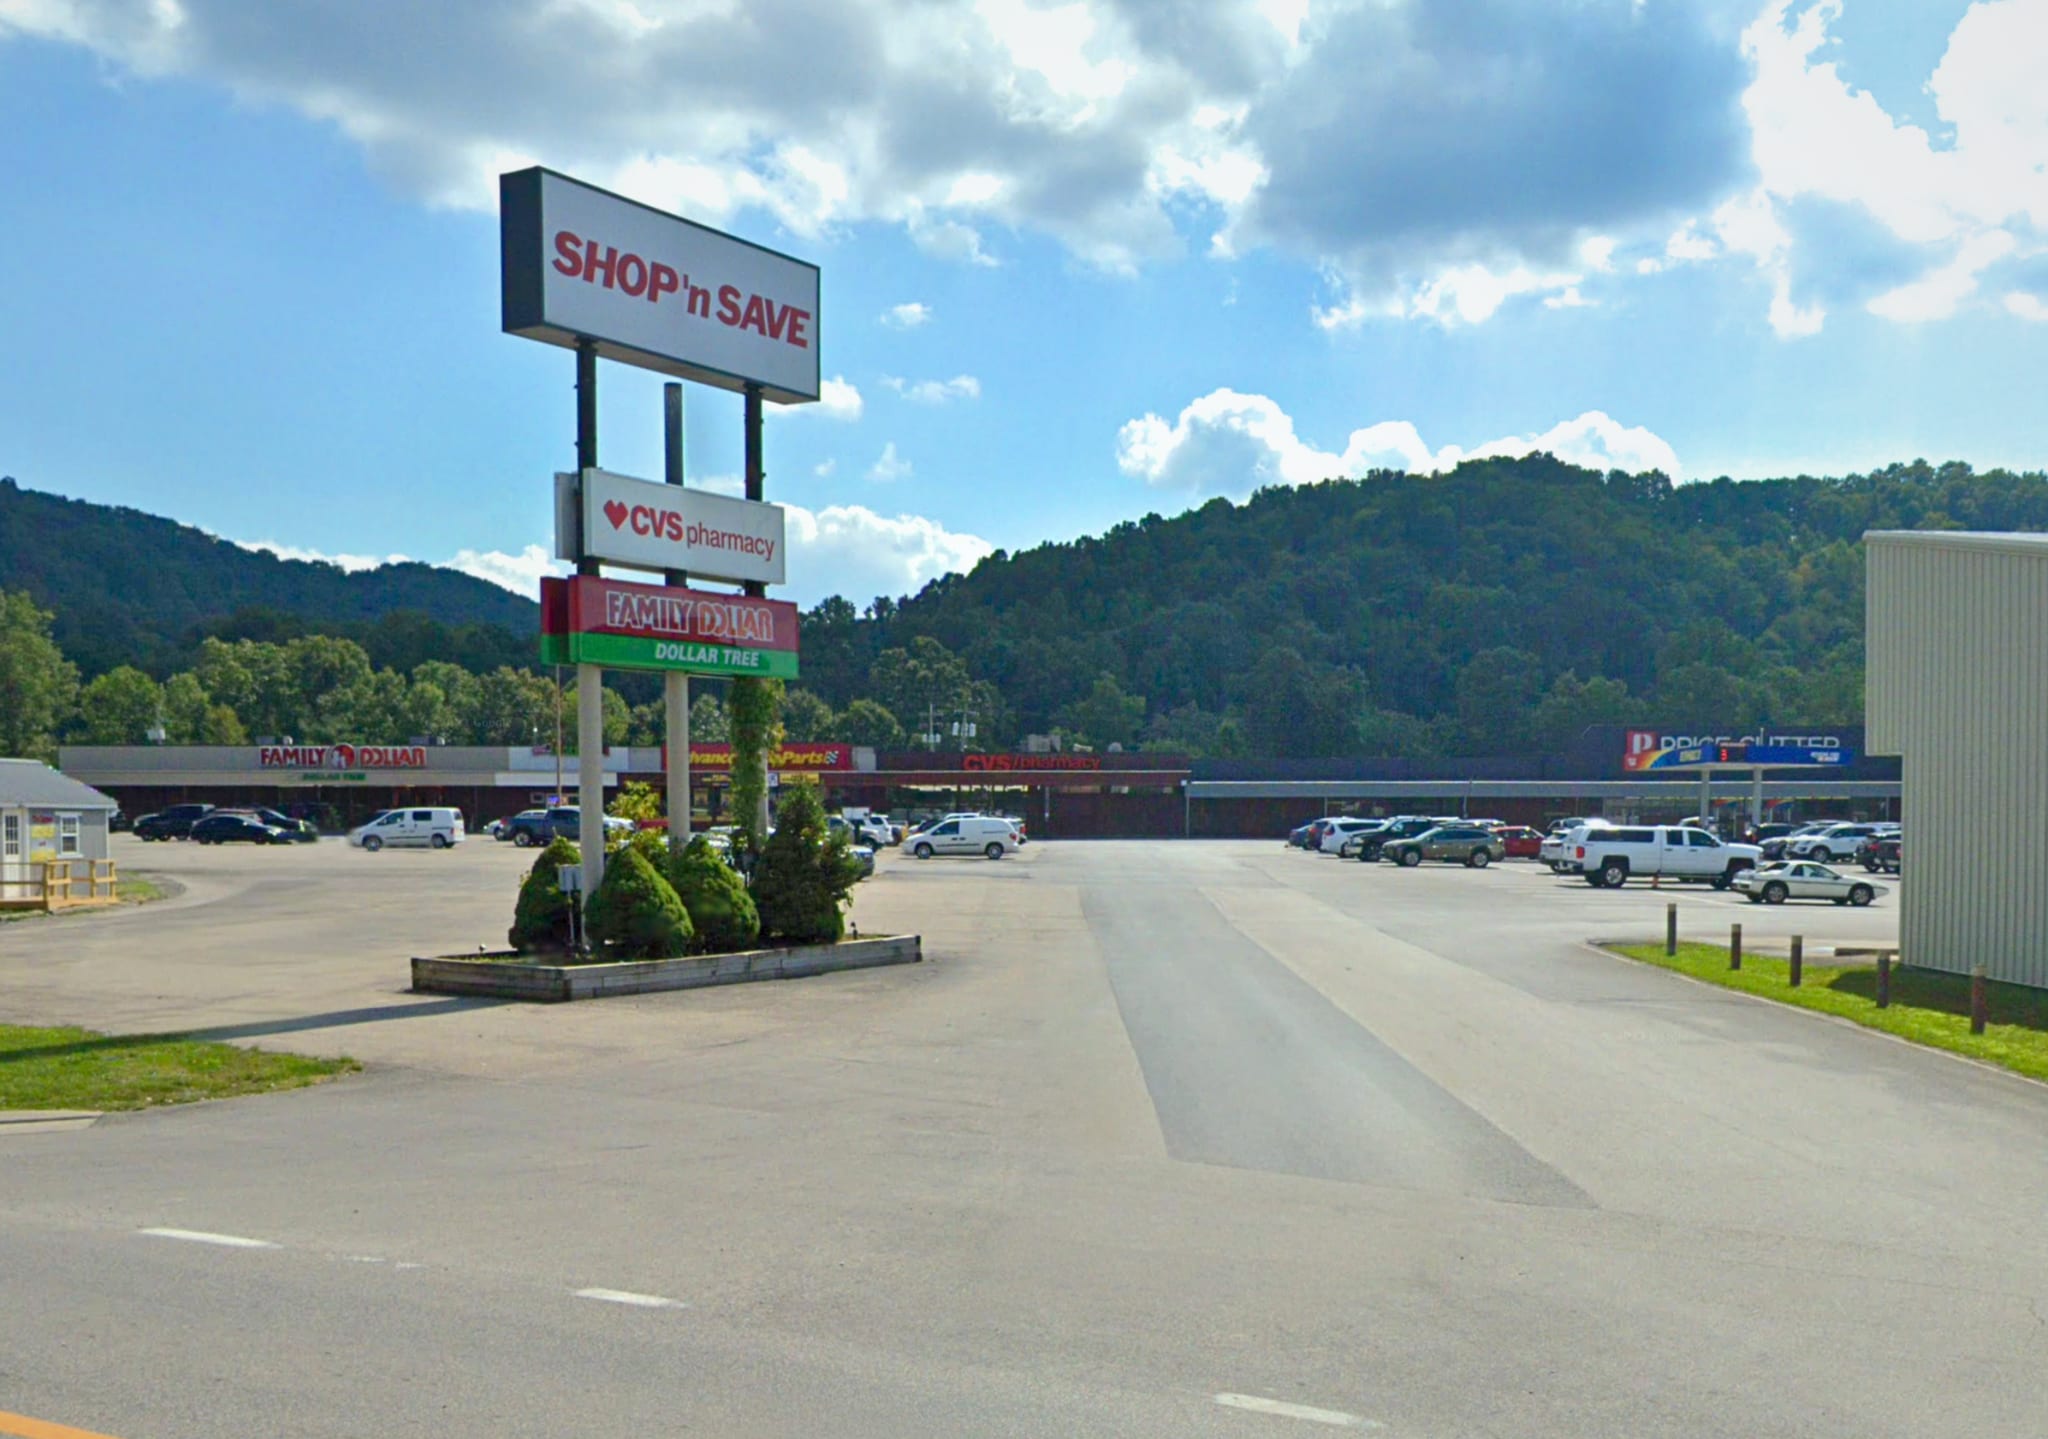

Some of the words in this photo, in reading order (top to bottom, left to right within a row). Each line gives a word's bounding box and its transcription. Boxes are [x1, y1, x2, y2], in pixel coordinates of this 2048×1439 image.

[552, 231, 679, 303] SHOP
[683, 274, 711, 318] 'n
[716, 284, 810, 348] SAVE
[630, 504, 684, 541] CVS
[687, 522, 775, 561] pharmacy
[606, 590, 692, 634] FAMILY
[698, 601, 773, 642] DOLLAR
[655, 643, 718, 664] DOLLAR
[723, 649, 759, 667] TREE
[260, 747, 327, 765] FAMILY
[360, 747, 427, 765] DOLLAR
[783, 751, 822, 765] Parts
